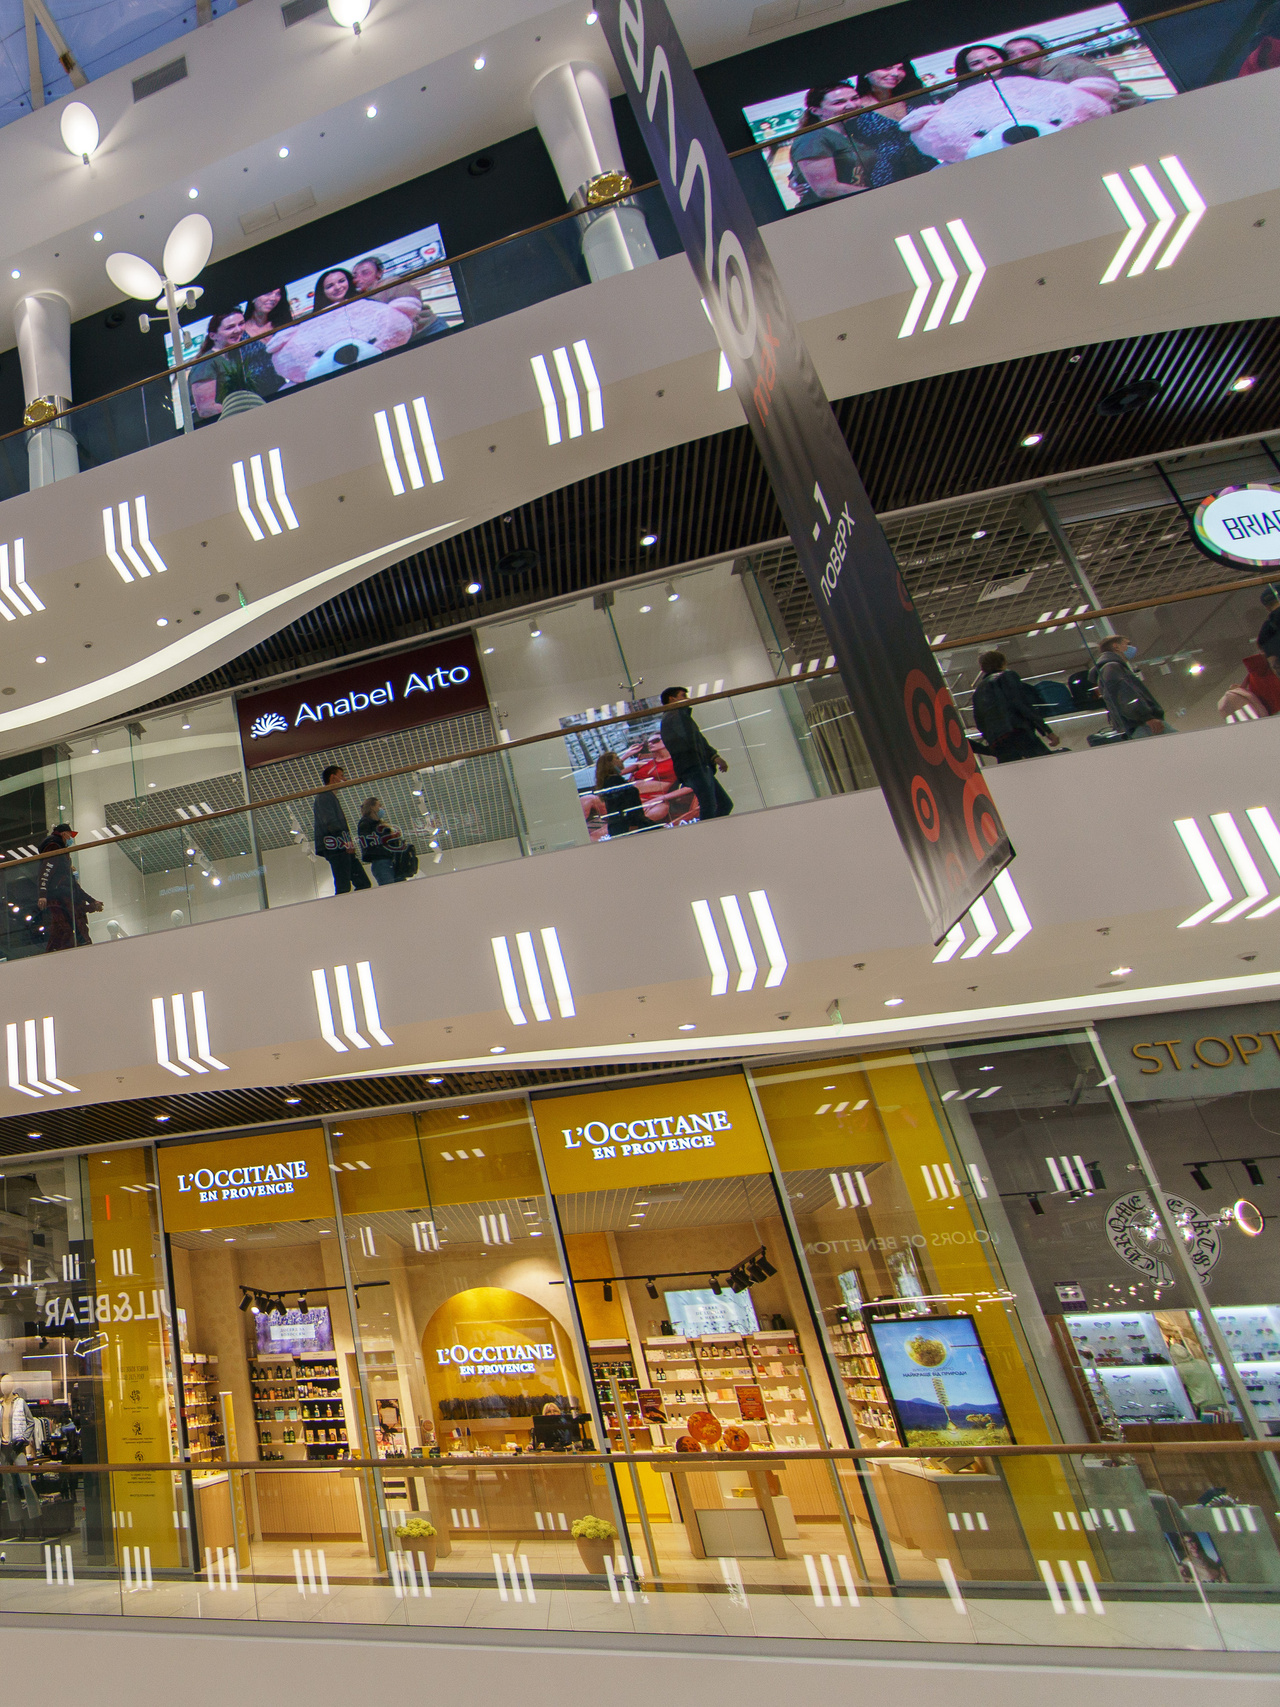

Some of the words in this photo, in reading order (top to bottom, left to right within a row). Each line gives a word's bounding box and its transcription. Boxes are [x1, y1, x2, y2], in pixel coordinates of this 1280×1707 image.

[820, 500, 856, 606] ПОВЕРХ
[295, 681, 395, 727] Anabel
[403, 665, 471, 698] Arto
[561, 1110, 733, 1149] L'OCCITANE
[592, 1146, 617, 1160] EN
[621, 1134, 715, 1157] PROVENCE
[177, 1160, 308, 1192] L'OCCITANE
[199, 1190, 219, 1202] EN
[221, 1182, 295, 1200] PROVENCE
[436, 1343, 556, 1365] L'OCCITANE
[459, 1365, 475, 1376] EN
[476, 1362, 536, 1375] PROVENCE
